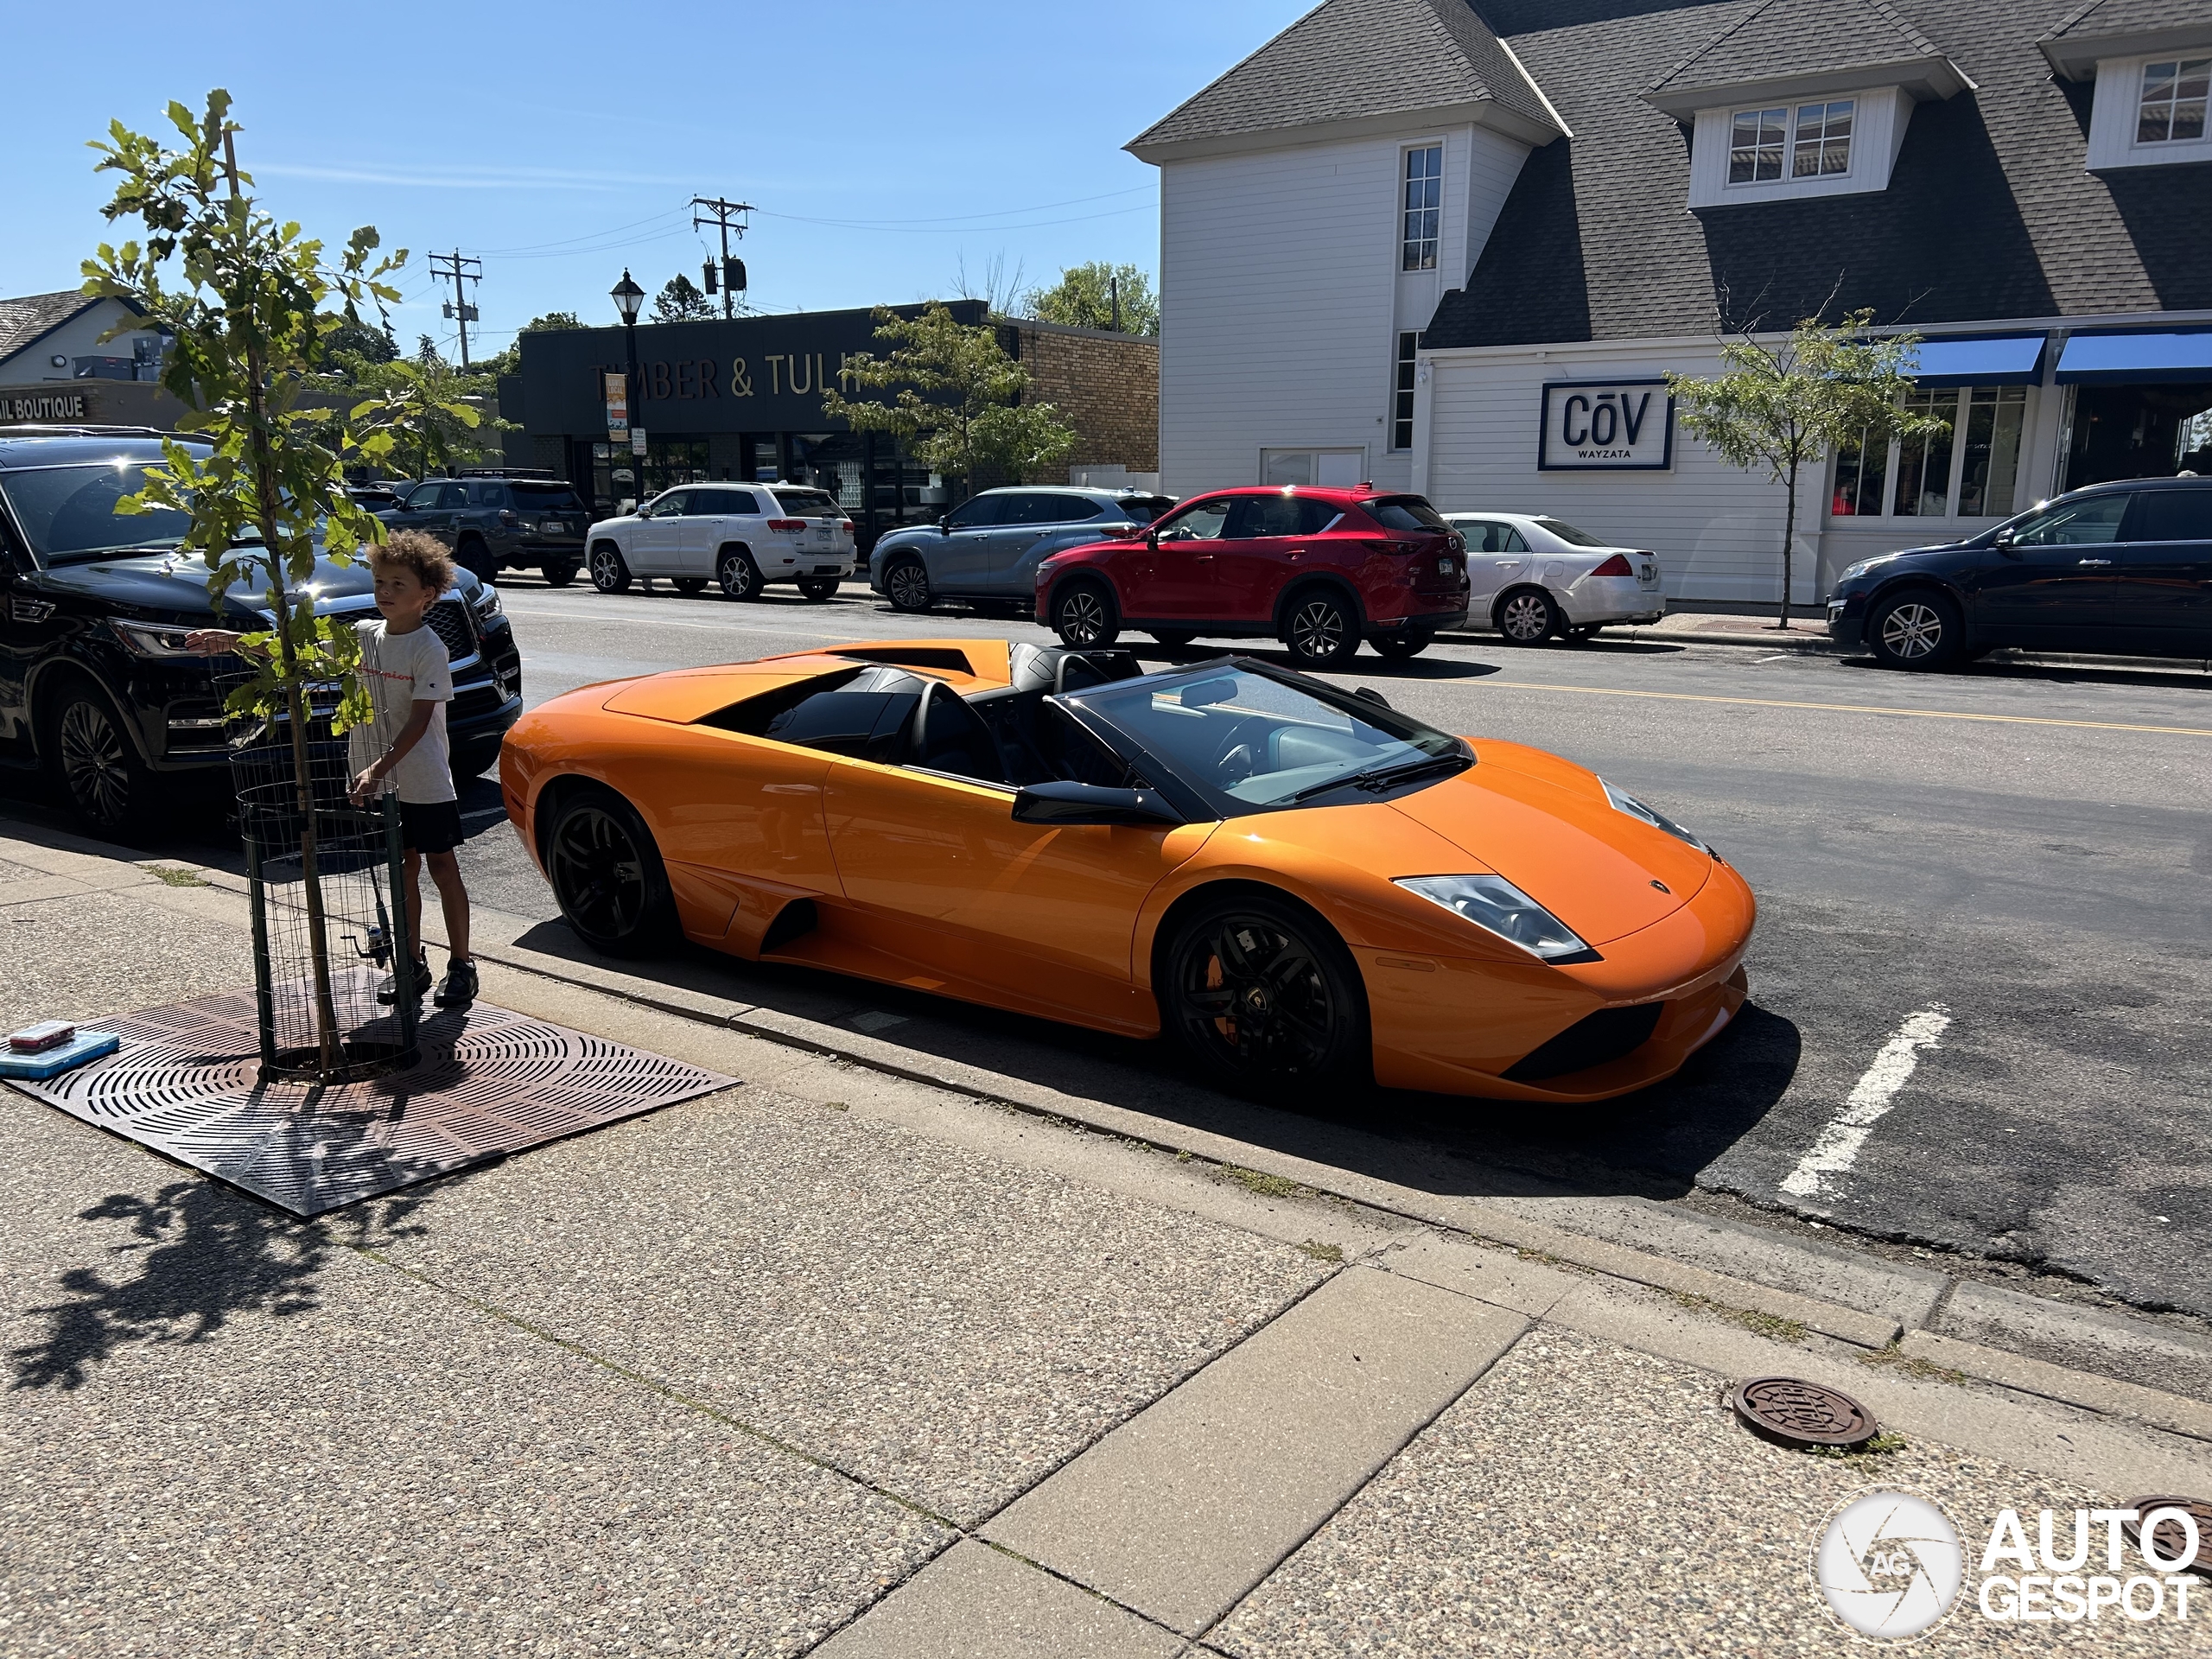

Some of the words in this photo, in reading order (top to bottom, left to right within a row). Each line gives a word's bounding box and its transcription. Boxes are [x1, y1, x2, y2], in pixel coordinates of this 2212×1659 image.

[589, 359, 720, 402] TMBER
[731, 357, 754, 397] &
[0, 399, 14, 420] IL
[15, 397, 84, 420] BOUTIQUE
[1578, 449, 1631, 459] WAYZATA
[1778, 1387, 1834, 1434] WATER
